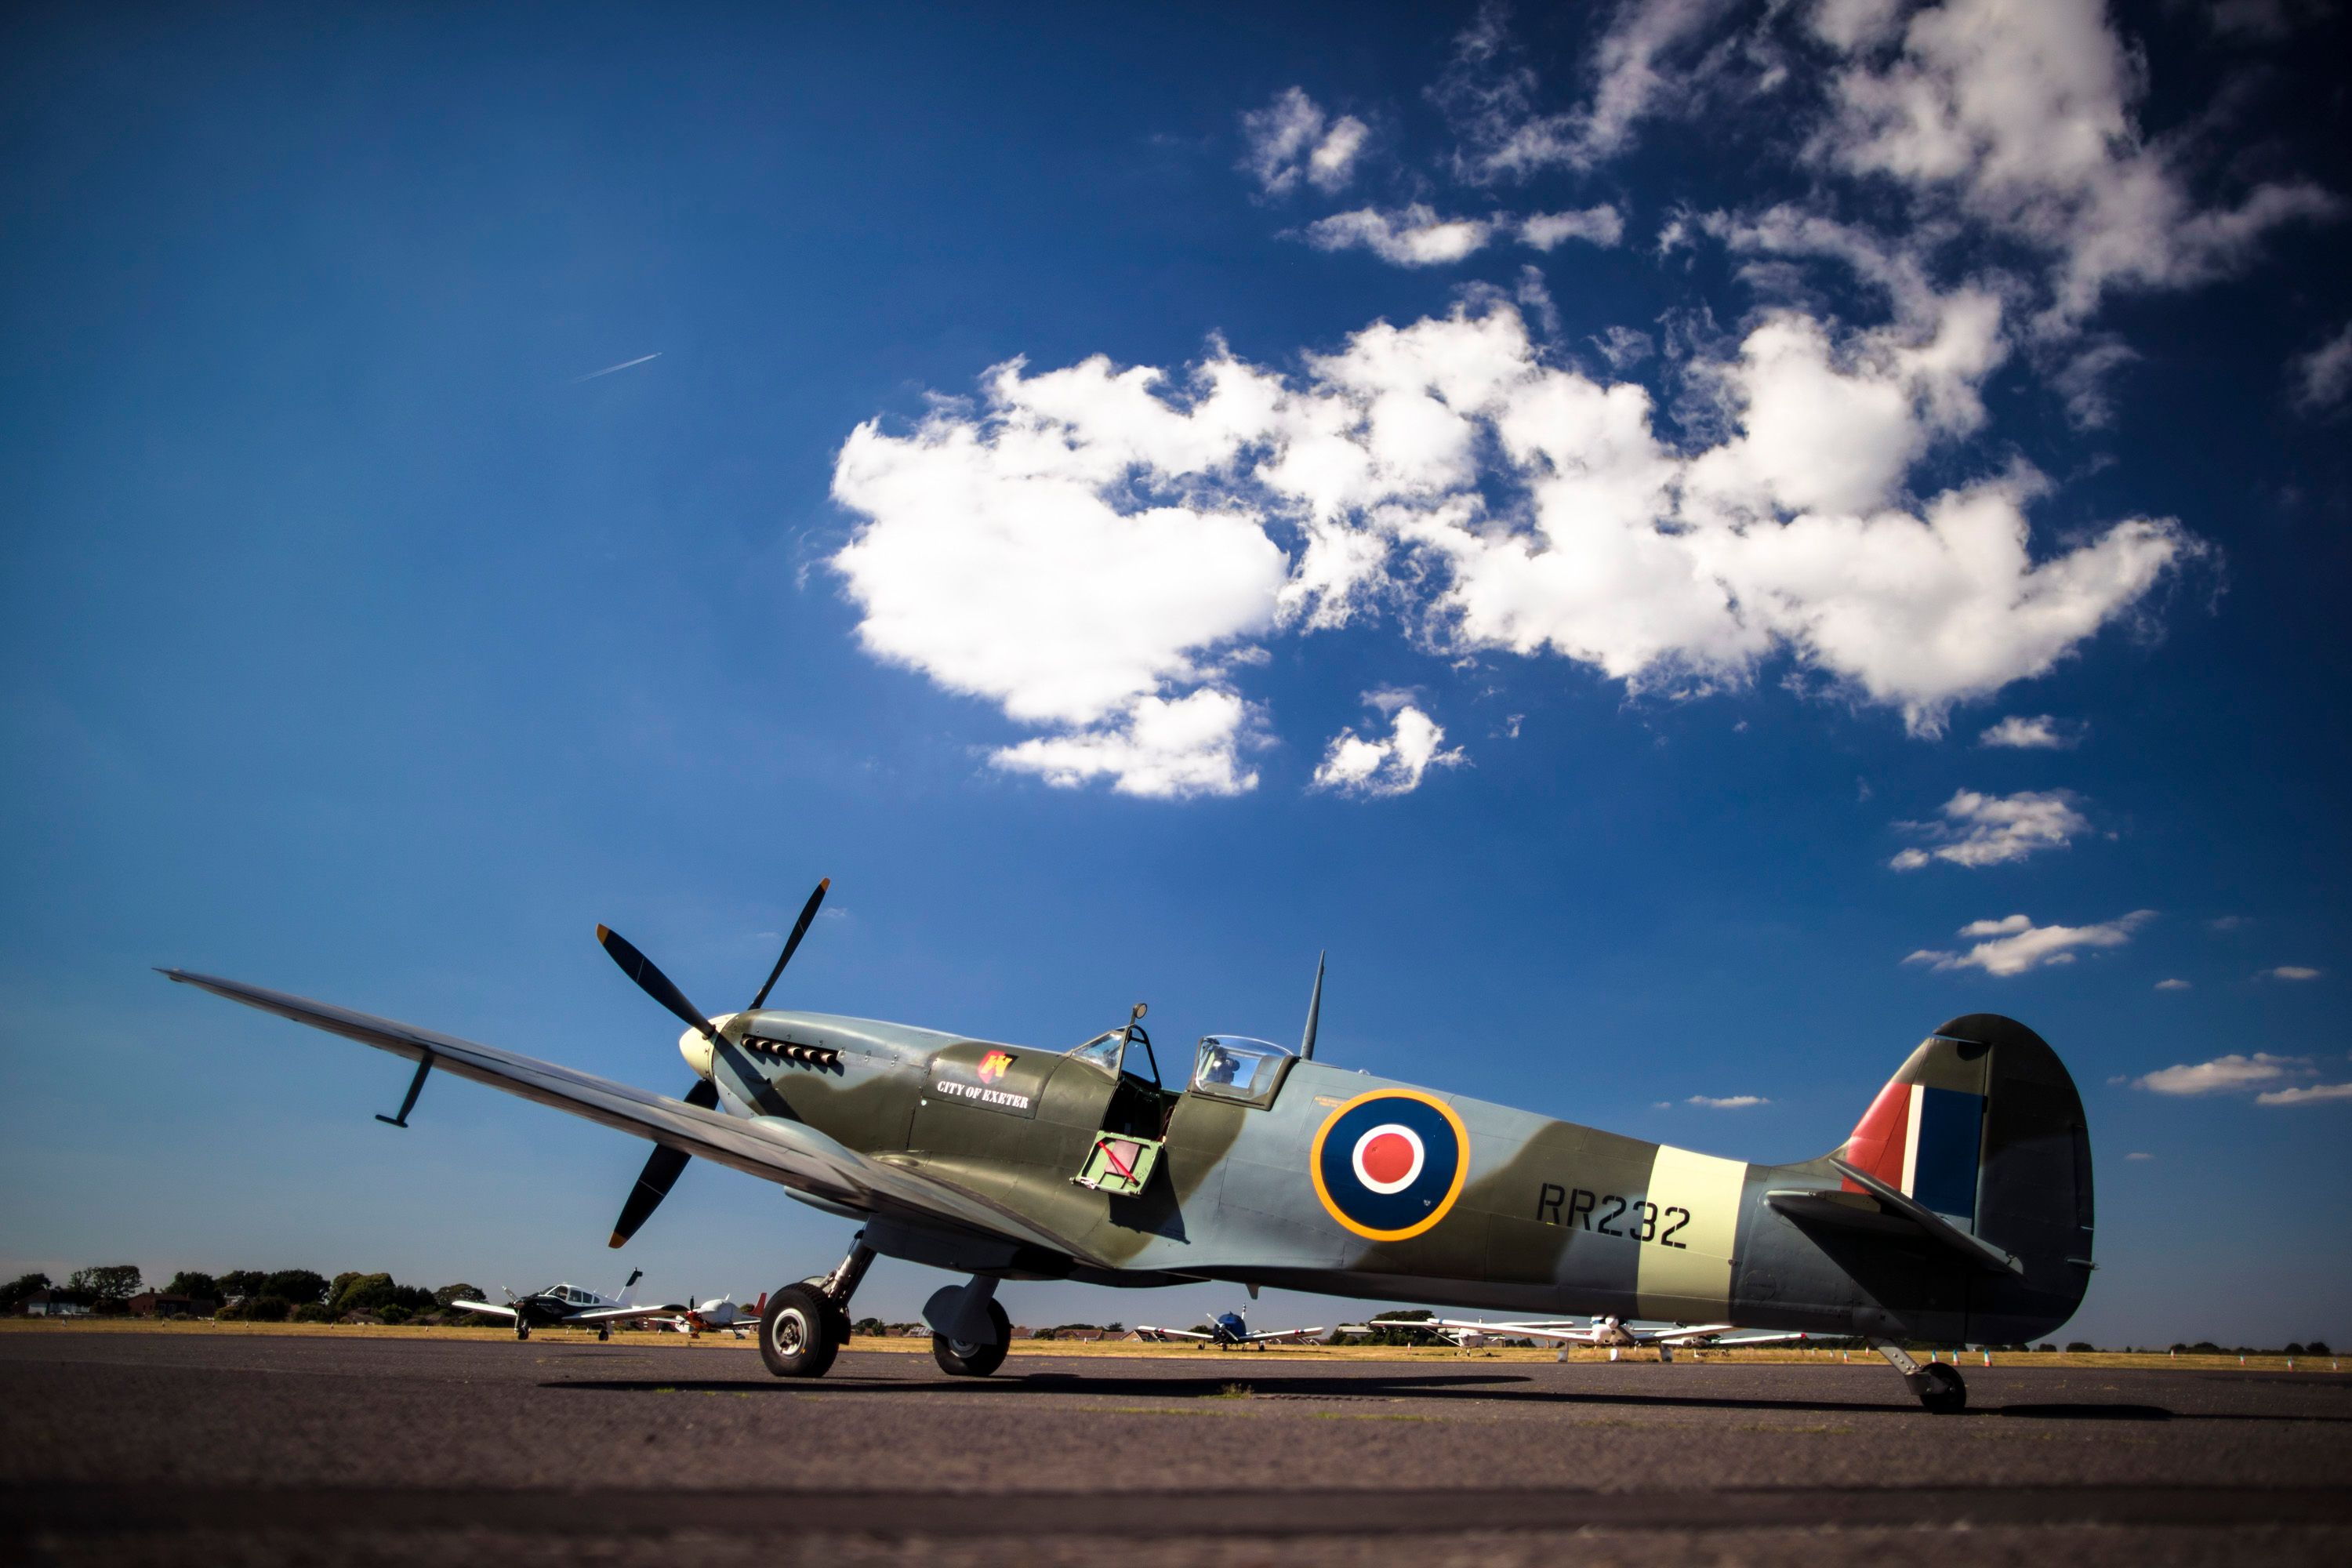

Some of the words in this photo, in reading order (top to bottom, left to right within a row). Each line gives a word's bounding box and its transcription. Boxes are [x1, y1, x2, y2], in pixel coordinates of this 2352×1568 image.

[937, 1081, 965, 1096] CITY
[965, 1087, 982, 1099] OF
[982, 1089, 1029, 1109] EXETER
[1537, 1183, 1690, 1249] RR232
